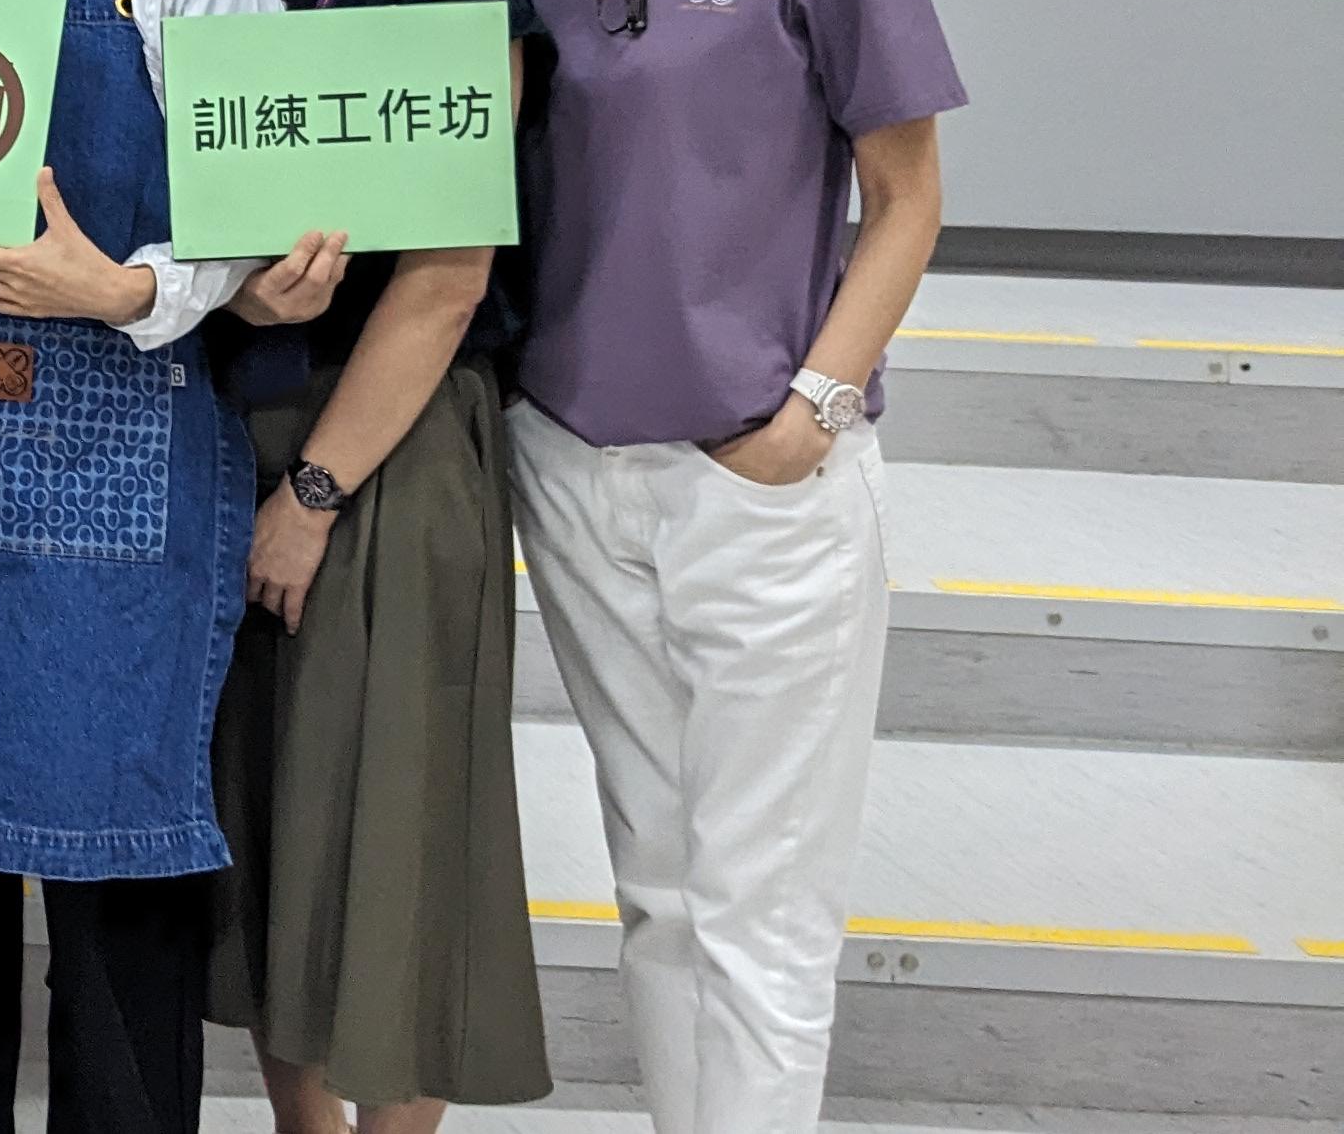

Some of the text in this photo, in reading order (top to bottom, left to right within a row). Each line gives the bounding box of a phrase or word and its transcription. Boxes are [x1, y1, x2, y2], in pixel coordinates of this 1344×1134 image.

[192, 84, 493, 152] 訓練工作坊
